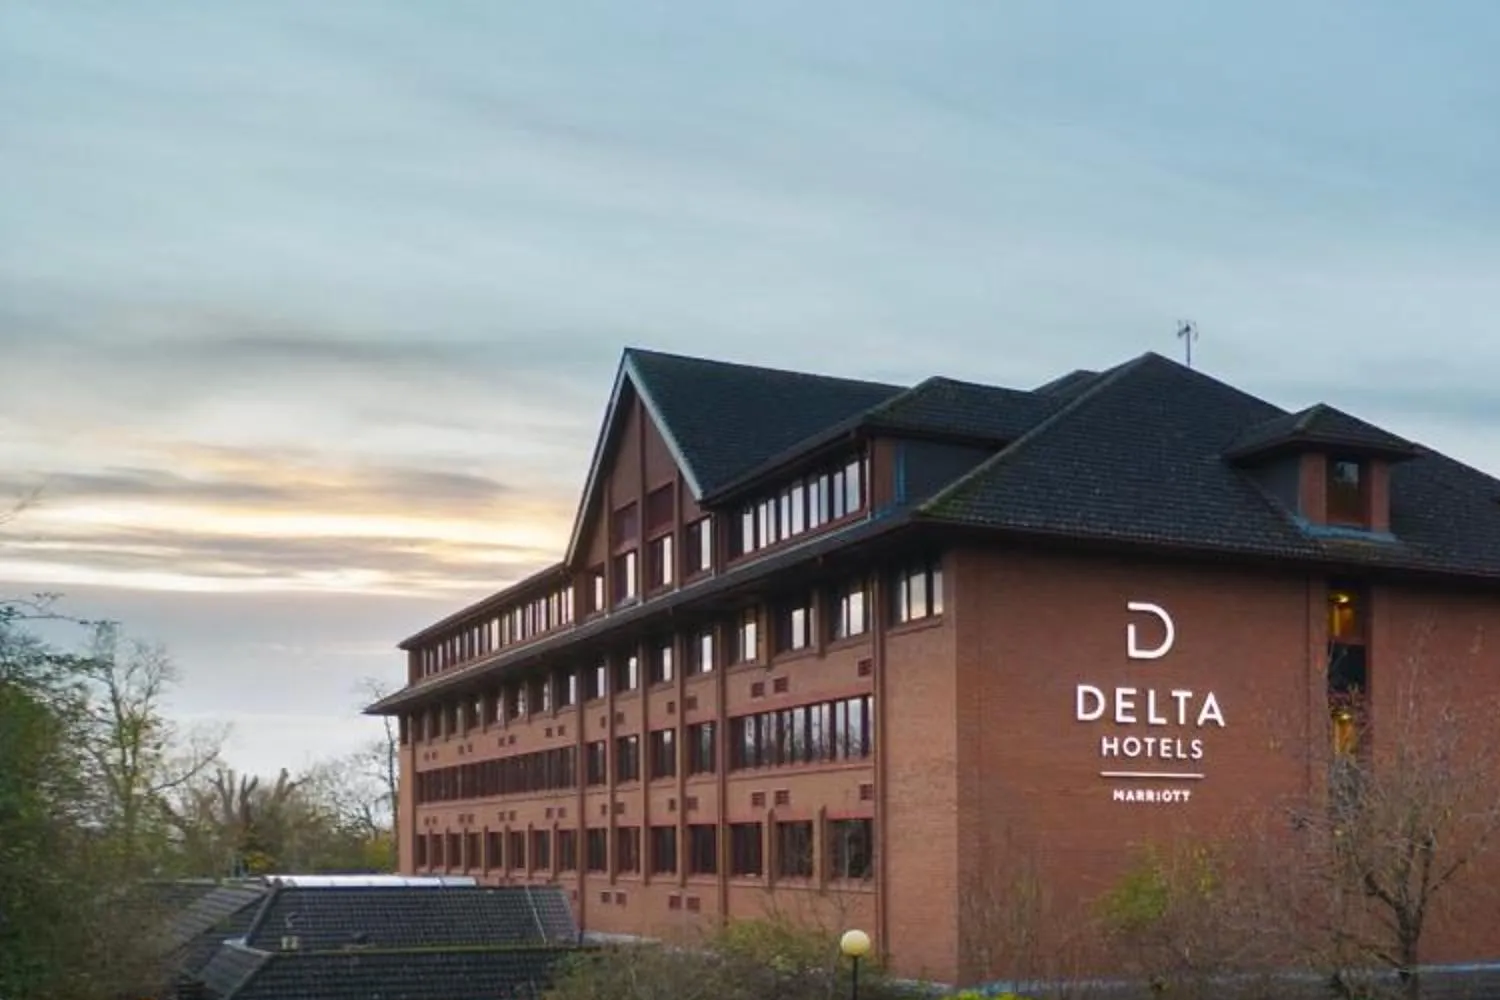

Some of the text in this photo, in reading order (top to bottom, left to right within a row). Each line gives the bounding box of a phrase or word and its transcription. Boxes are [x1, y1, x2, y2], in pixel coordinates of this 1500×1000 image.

[1127, 601, 1175, 659] D
[1076, 684, 1225, 728] DELTA
[1101, 735, 1204, 760] HOTELS
[1112, 788, 1191, 803] MARRIOTT
